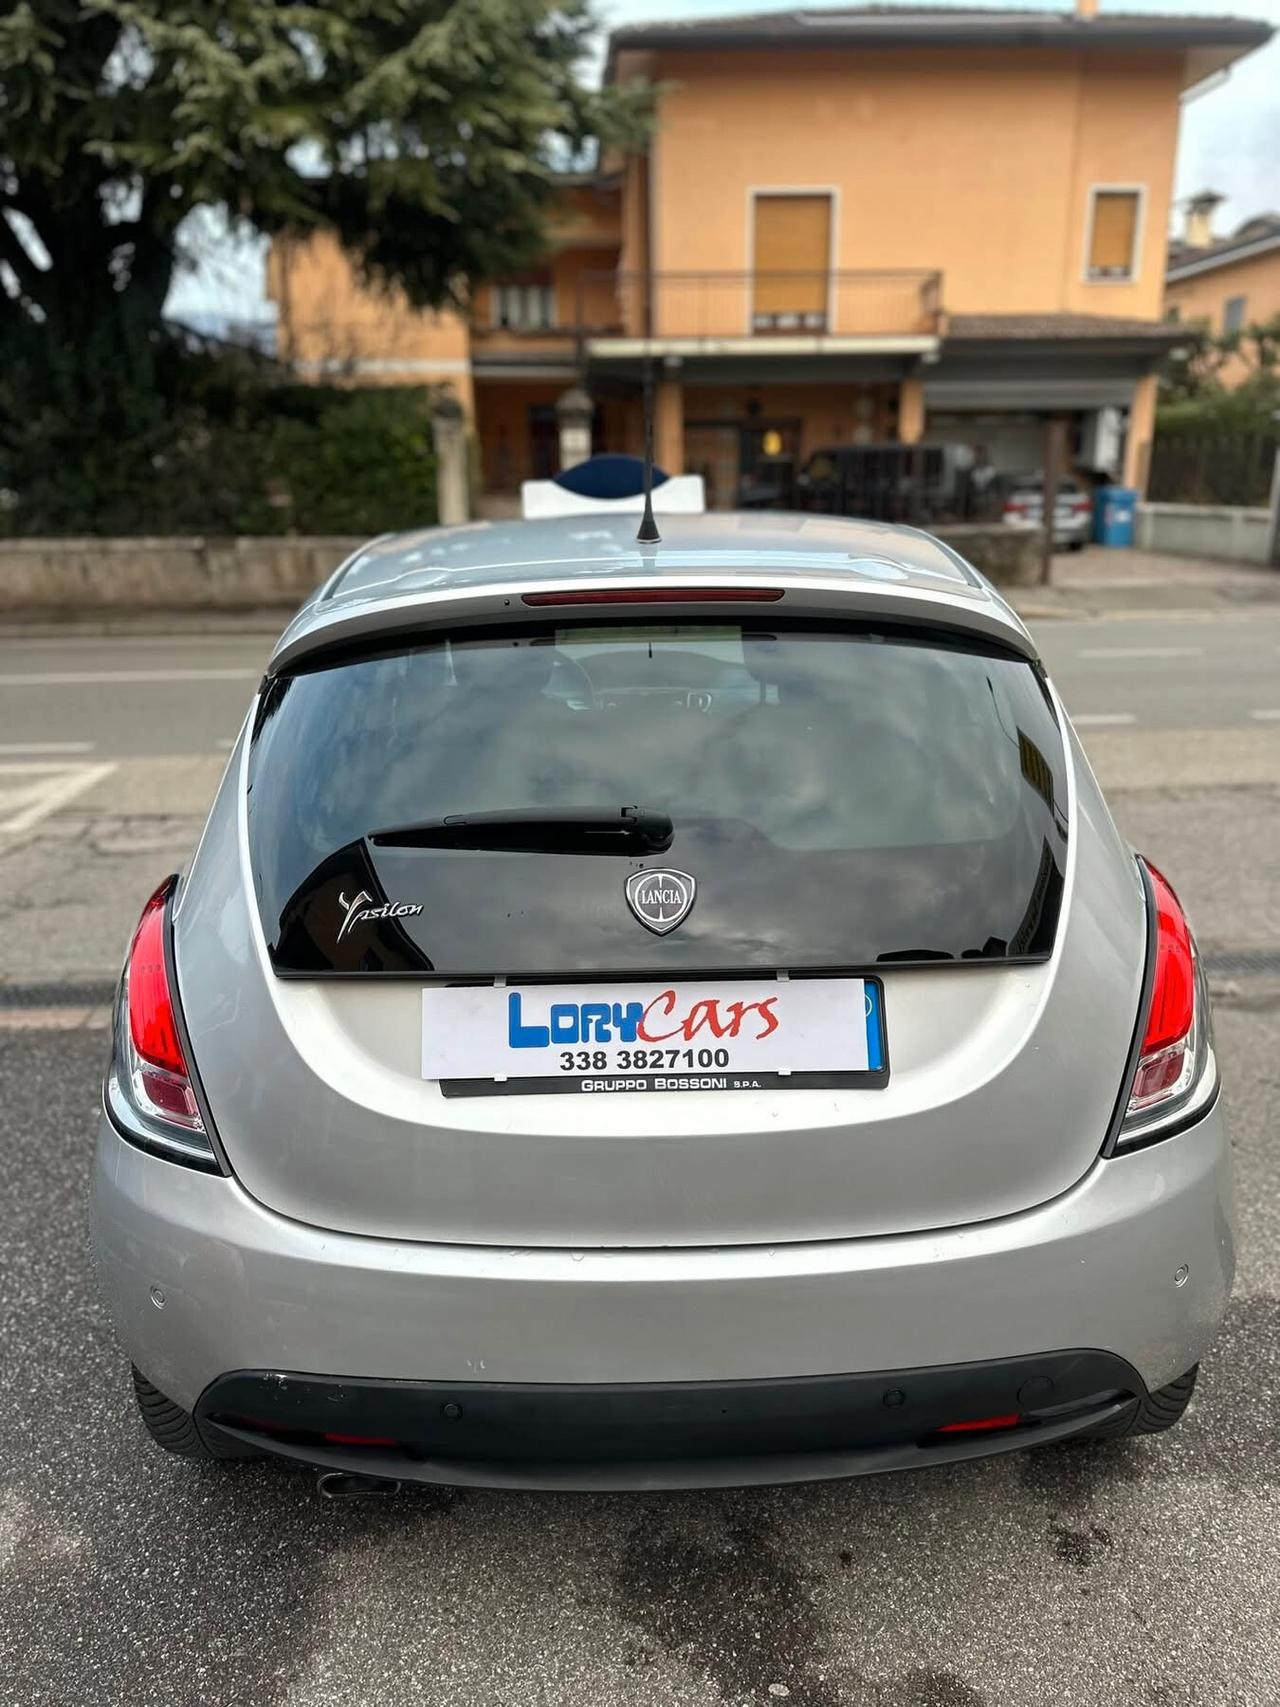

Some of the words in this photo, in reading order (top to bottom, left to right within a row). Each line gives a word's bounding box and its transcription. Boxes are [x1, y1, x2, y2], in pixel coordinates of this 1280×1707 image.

[641, 889, 682, 905] LANCIA
[336, 890, 423, 943] Ypsilon
[560, 1051, 608, 1070] 338
[616, 1048, 730, 1070] 3827100
[581, 1079, 647, 1091] GRUPPO
[654, 1078, 727, 1089] BOSSONI
[734, 1081, 762, 1089] S.P.A.
